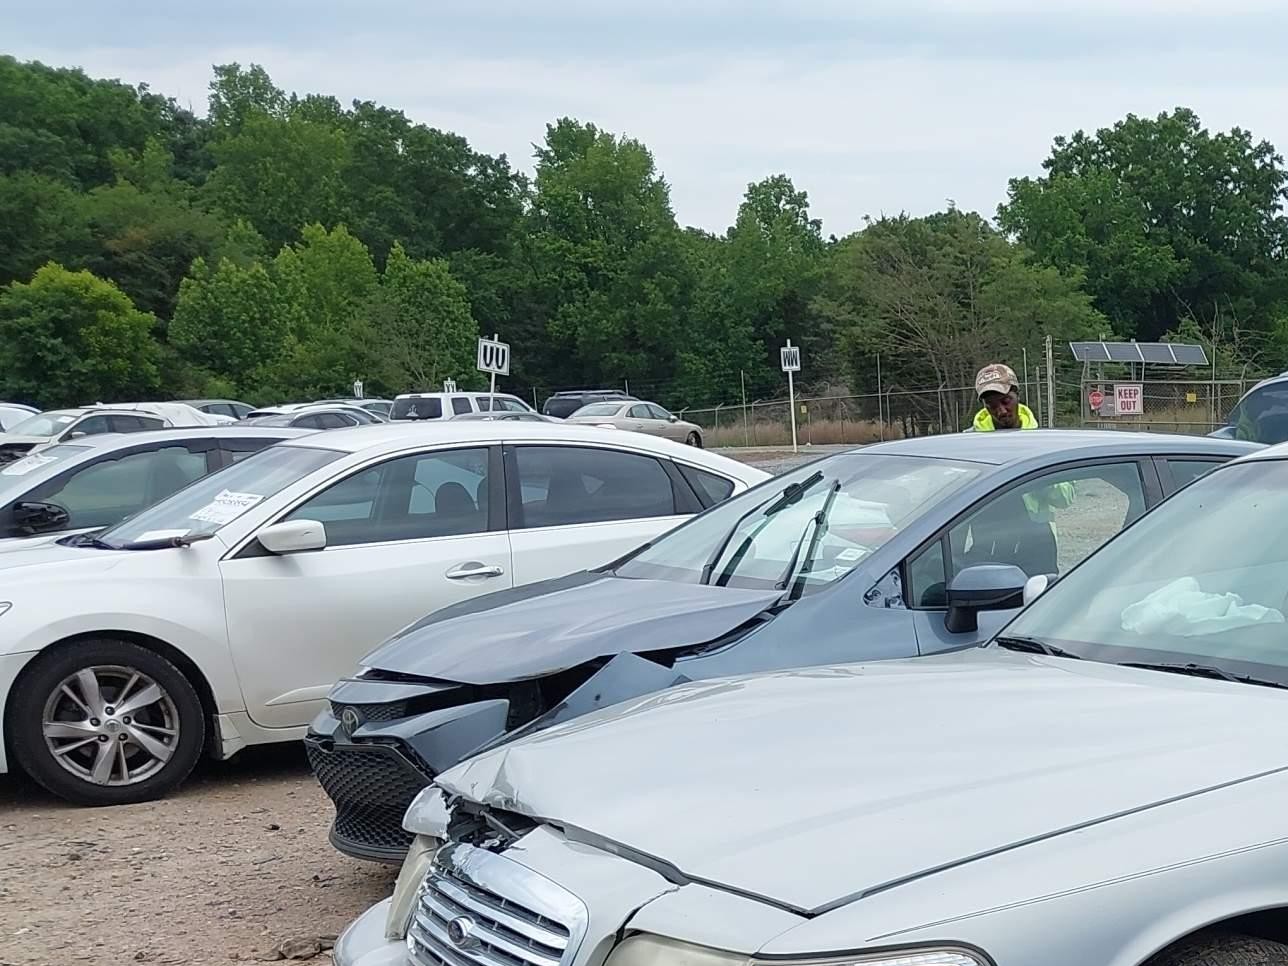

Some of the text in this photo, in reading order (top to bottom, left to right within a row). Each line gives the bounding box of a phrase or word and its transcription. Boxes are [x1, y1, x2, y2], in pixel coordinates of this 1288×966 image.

[483, 345, 506, 369] UU
[782, 350, 798, 367] WW
[1118, 388, 1139, 399] KEEP
[1120, 400, 1137, 410] OUT
